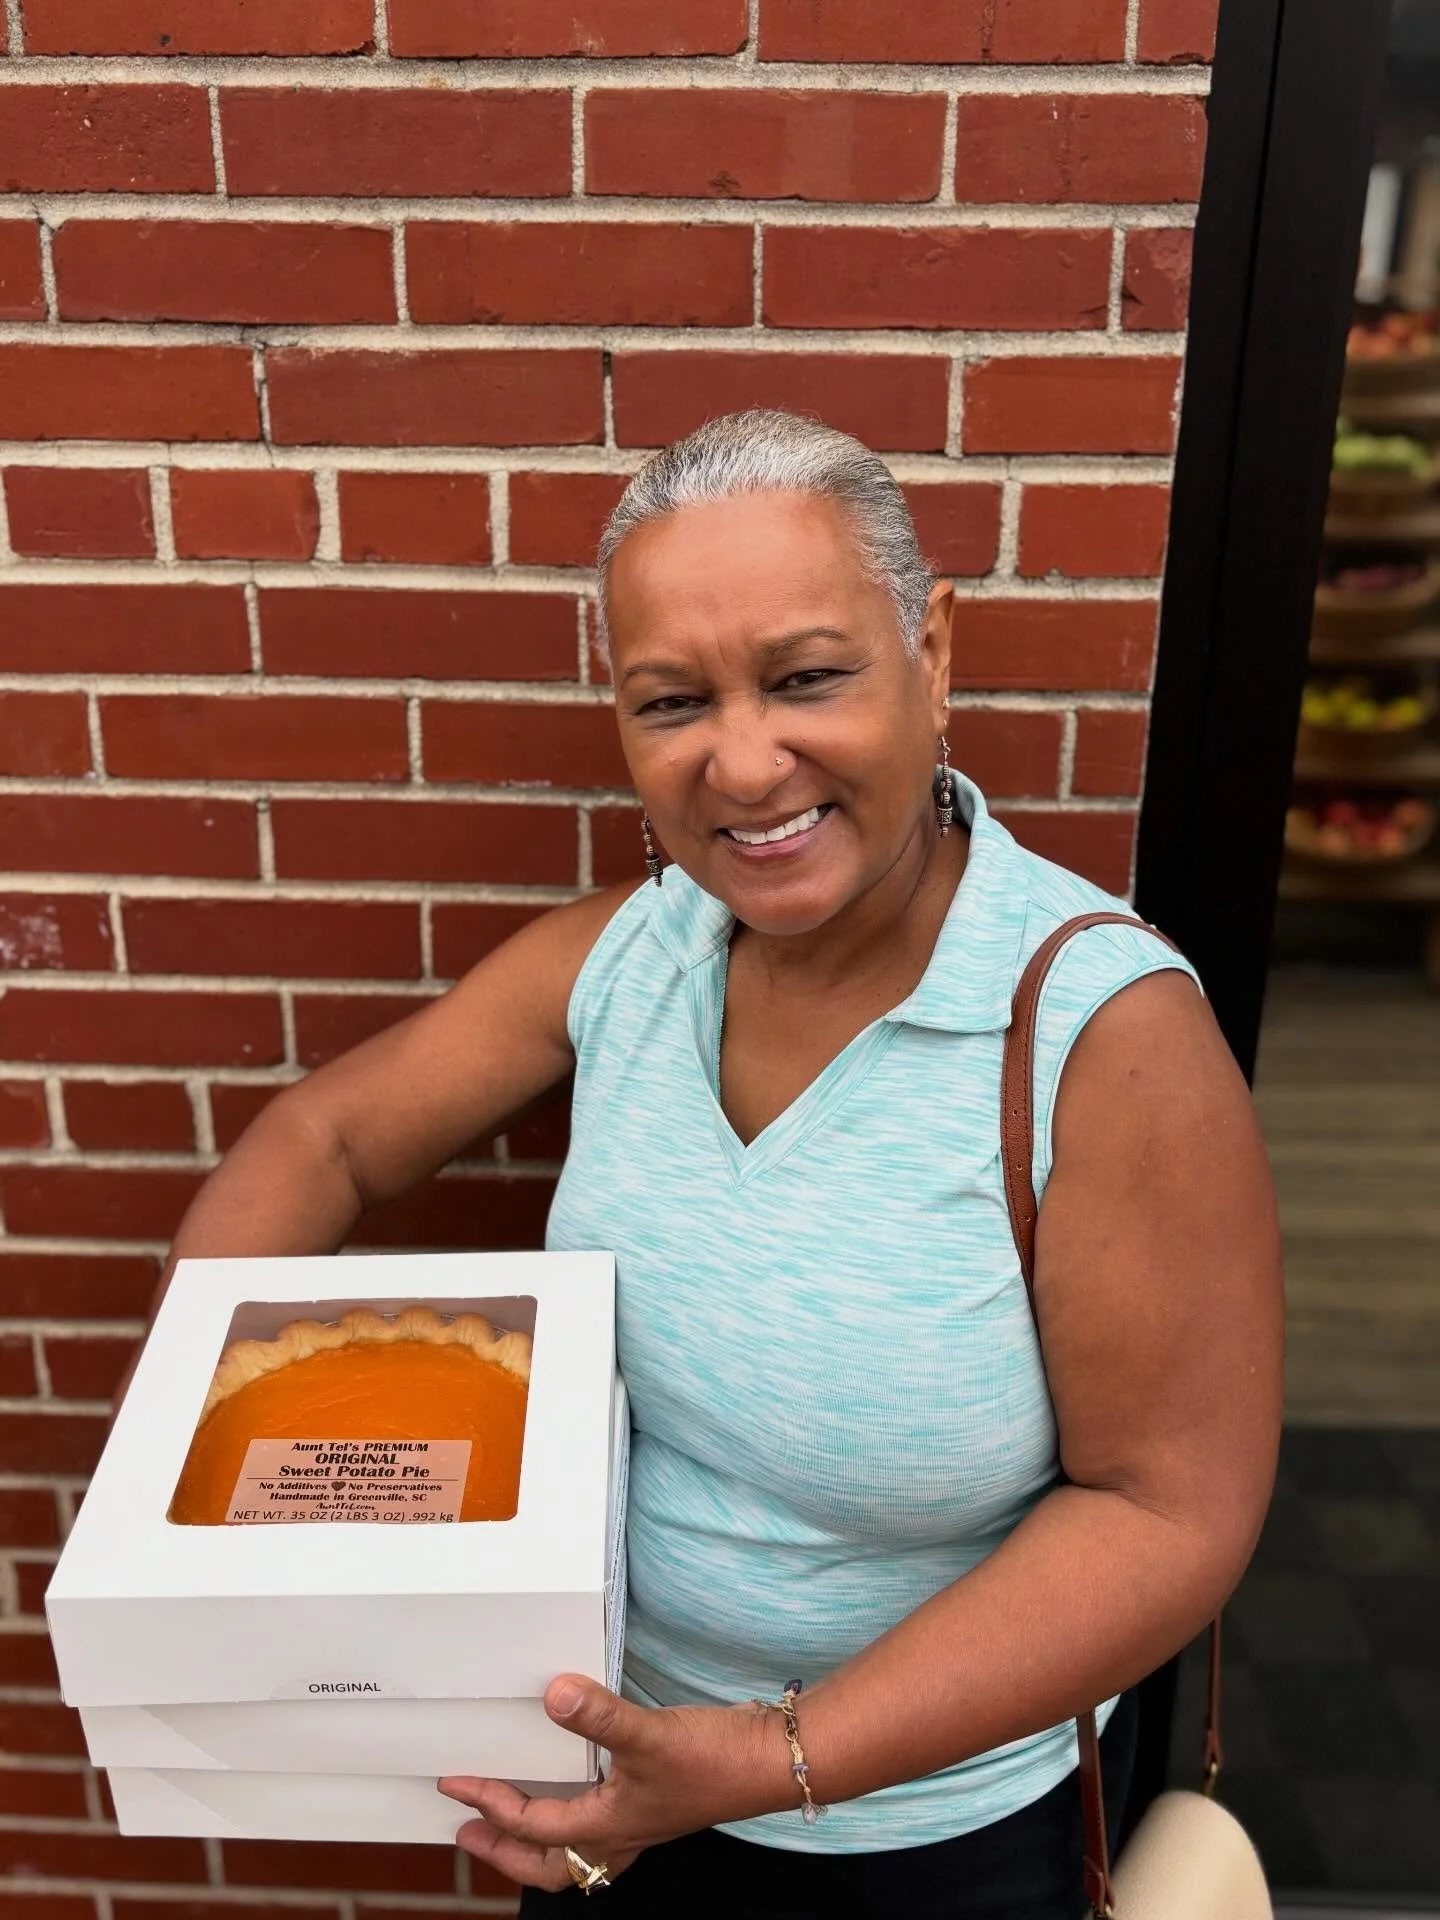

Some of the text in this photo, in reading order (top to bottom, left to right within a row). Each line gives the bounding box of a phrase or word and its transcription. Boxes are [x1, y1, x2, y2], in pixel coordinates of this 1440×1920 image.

[291, 1442, 429, 1452] Aunt Tel's PREMIUM
[315, 1452, 400, 1465] ORIGINAL
[279, 1465, 430, 1477] Sweet Potato Pie
[259, 1481, 442, 1491] No Additives No Preservatives
[270, 1492, 428, 1502] Handmade in Greenville, SC
[233, 1510, 454, 1523] NET WT. 35 OZ (2 LBS 3 OZ) .992 kg
[308, 1682, 382, 1693] ORIGINAL
